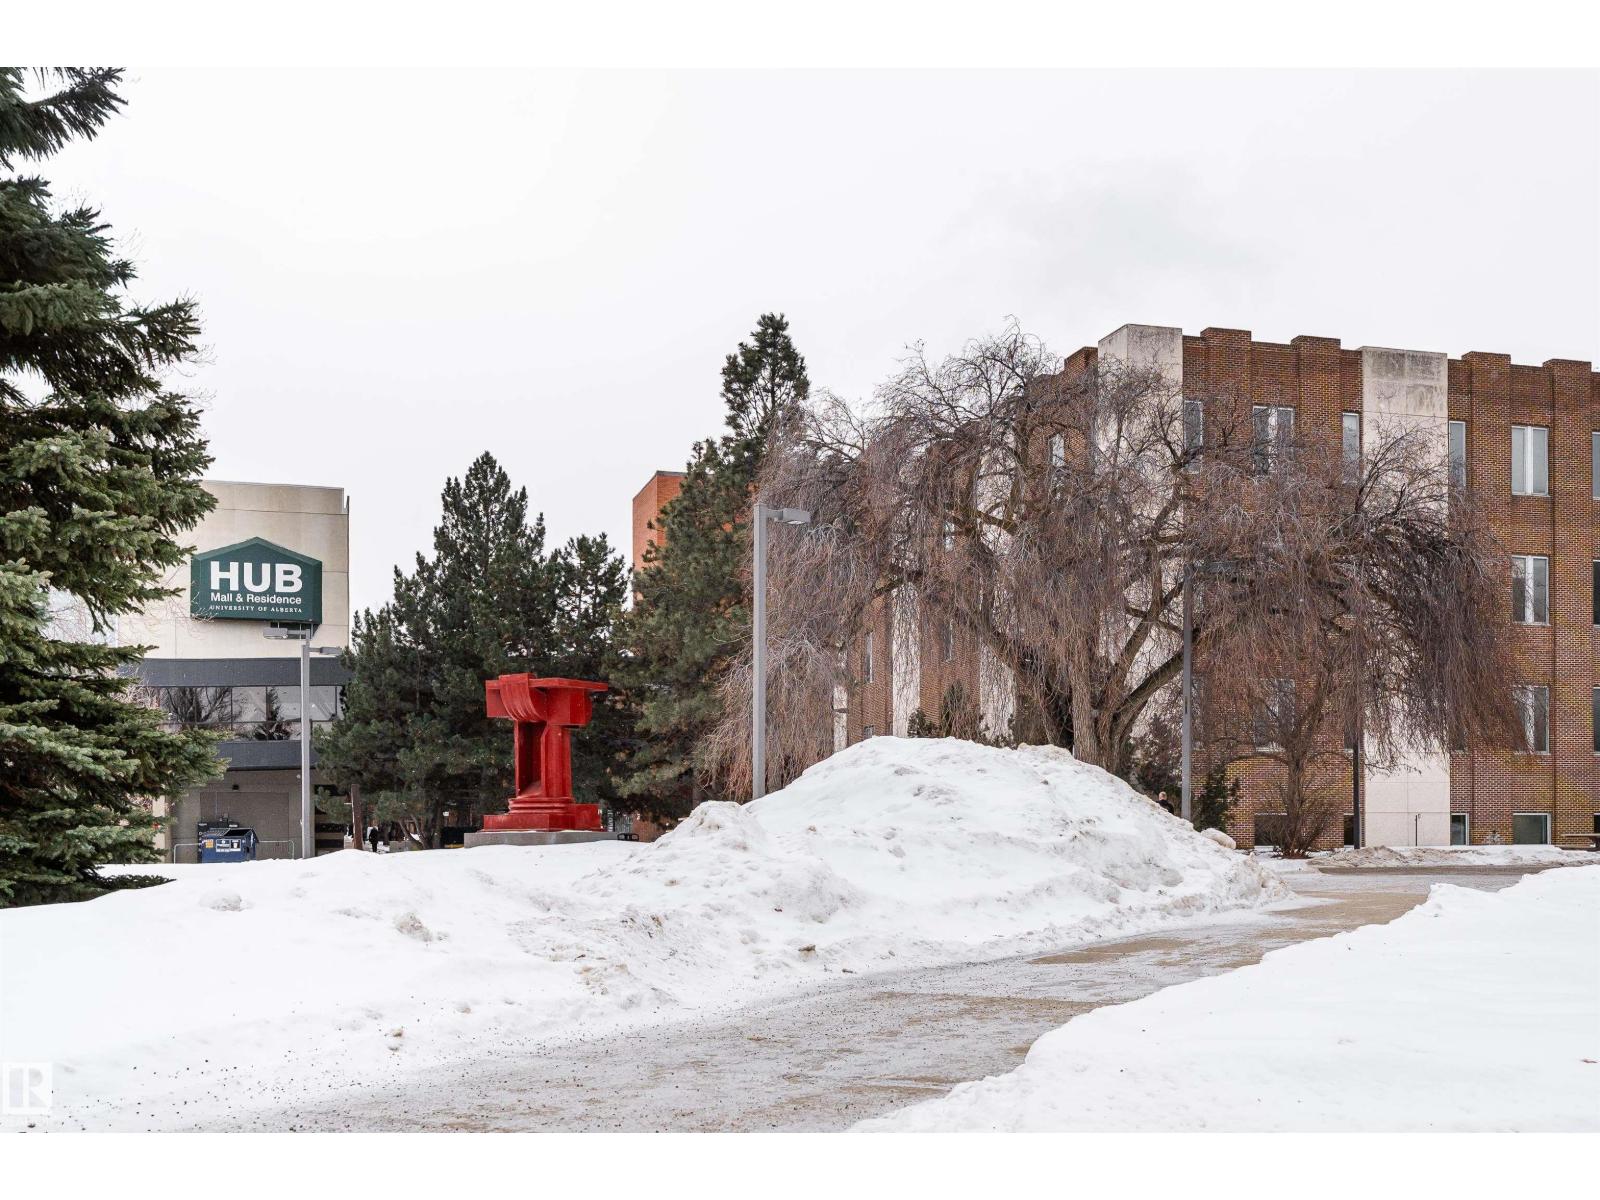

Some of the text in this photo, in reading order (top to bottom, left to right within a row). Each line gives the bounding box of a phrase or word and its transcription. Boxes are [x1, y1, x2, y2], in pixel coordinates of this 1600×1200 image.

[210, 561, 303, 593] HUB
[210, 592, 302, 605] Mall & Residence
